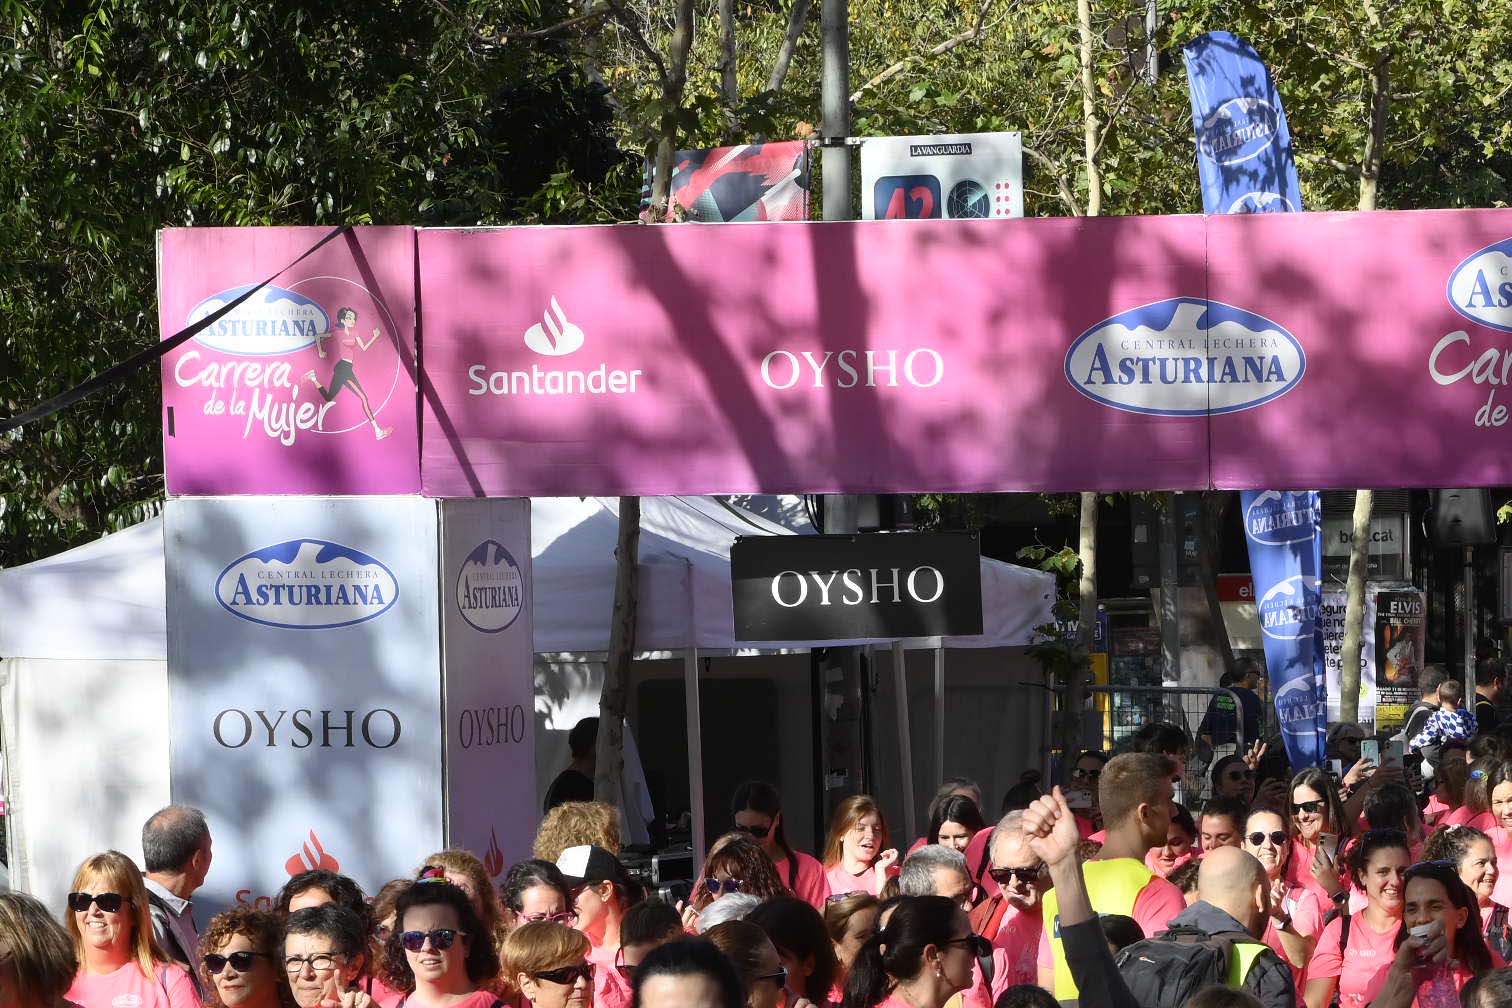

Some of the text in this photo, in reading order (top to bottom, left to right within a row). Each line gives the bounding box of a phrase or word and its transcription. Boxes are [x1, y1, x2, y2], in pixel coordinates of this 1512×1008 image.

[1120, 337, 1279, 350] CENTRAL LECHERA
[174, 351, 293, 388] Carrera
[468, 364, 642, 396] Santander
[760, 348, 945, 391] OYSHO
[1084, 342, 1287, 385] ASTURIANA
[203, 384, 337, 446] de la Mujer
[1474, 389, 1509, 427] de
[229, 572, 385, 606] ASTURIANA
[257, 570, 379, 580] CENTRAL LECHERA
[461, 575, 520, 610] ASTURIANA
[771, 565, 944, 608] OYSHO
[1390, 601, 1420, 613] ELVIS
[213, 708, 402, 749] OYSHO
[459, 704, 525, 749] OYSHO
